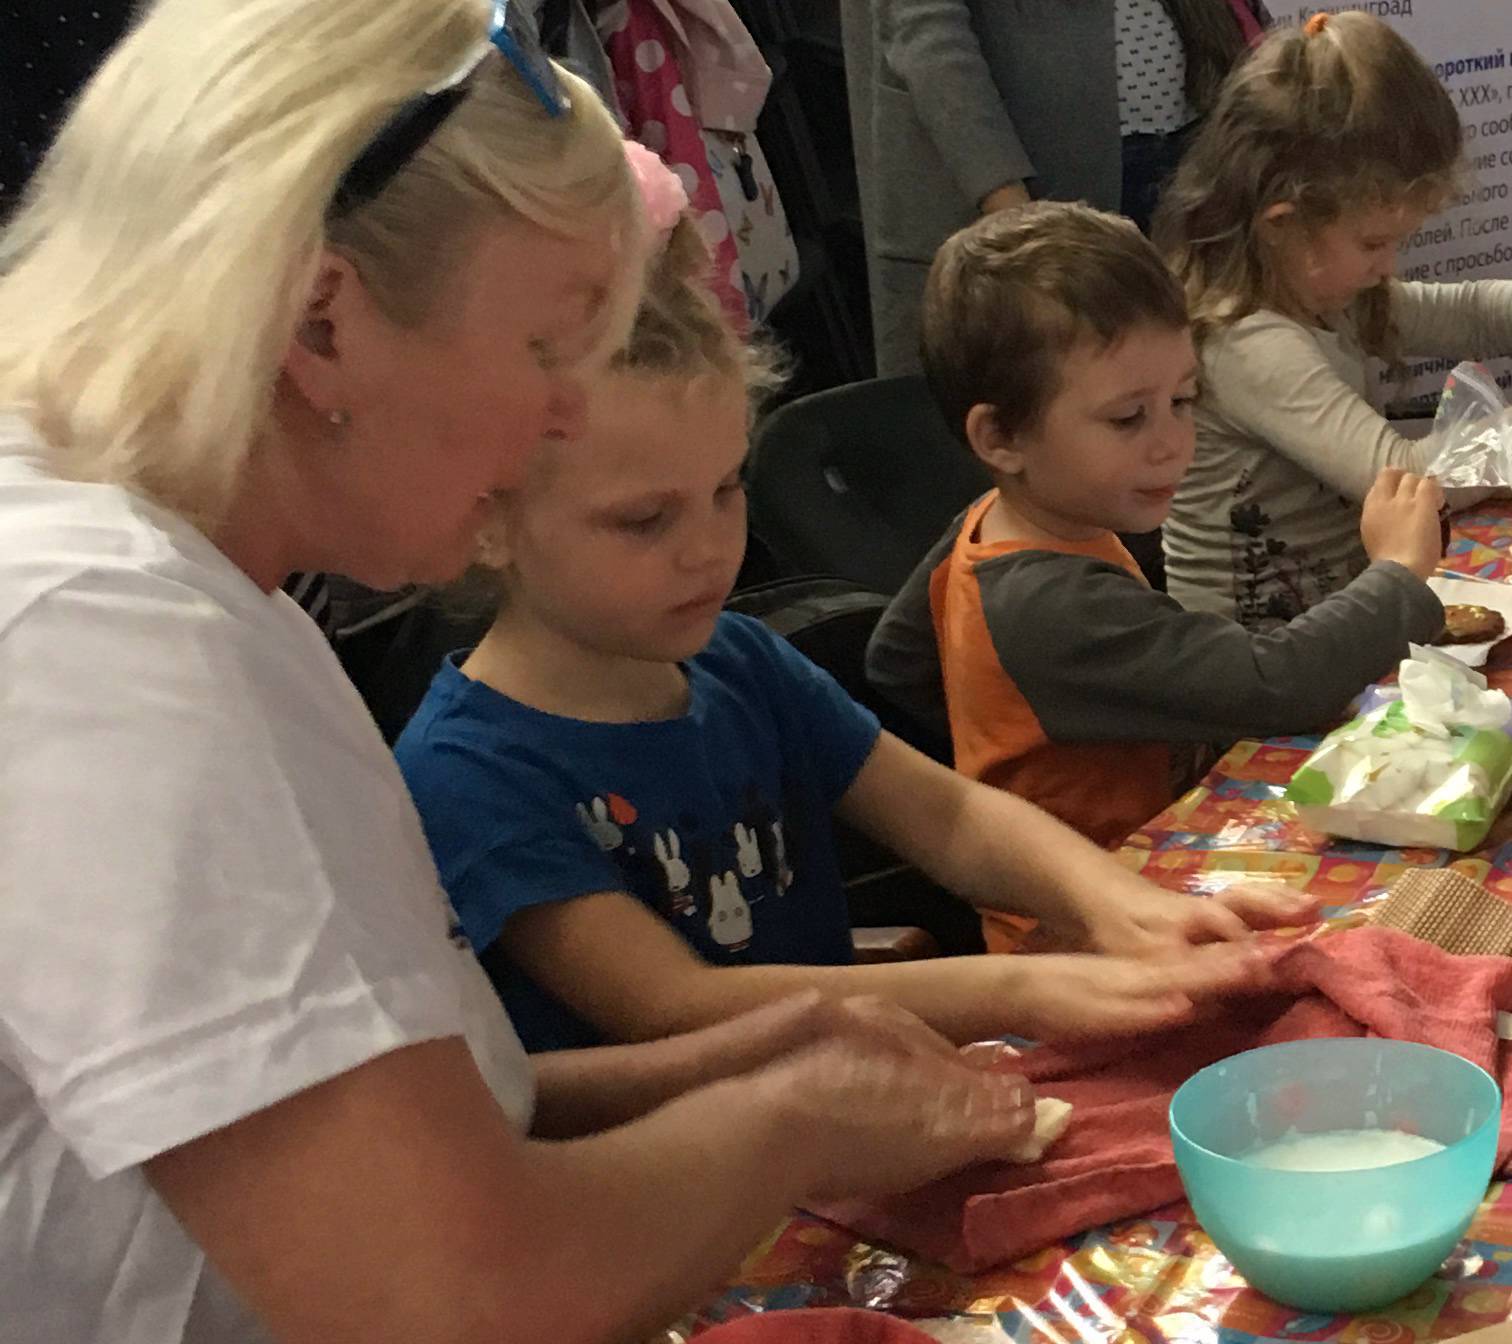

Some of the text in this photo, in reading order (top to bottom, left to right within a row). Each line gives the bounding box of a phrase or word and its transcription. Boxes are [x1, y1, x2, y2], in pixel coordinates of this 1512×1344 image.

[1434, 48, 1504, 82] ороткий
[1398, 223, 1456, 256] ублей.
[1460, 215, 1509, 239] После
[1434, 261, 1442, 277] с
